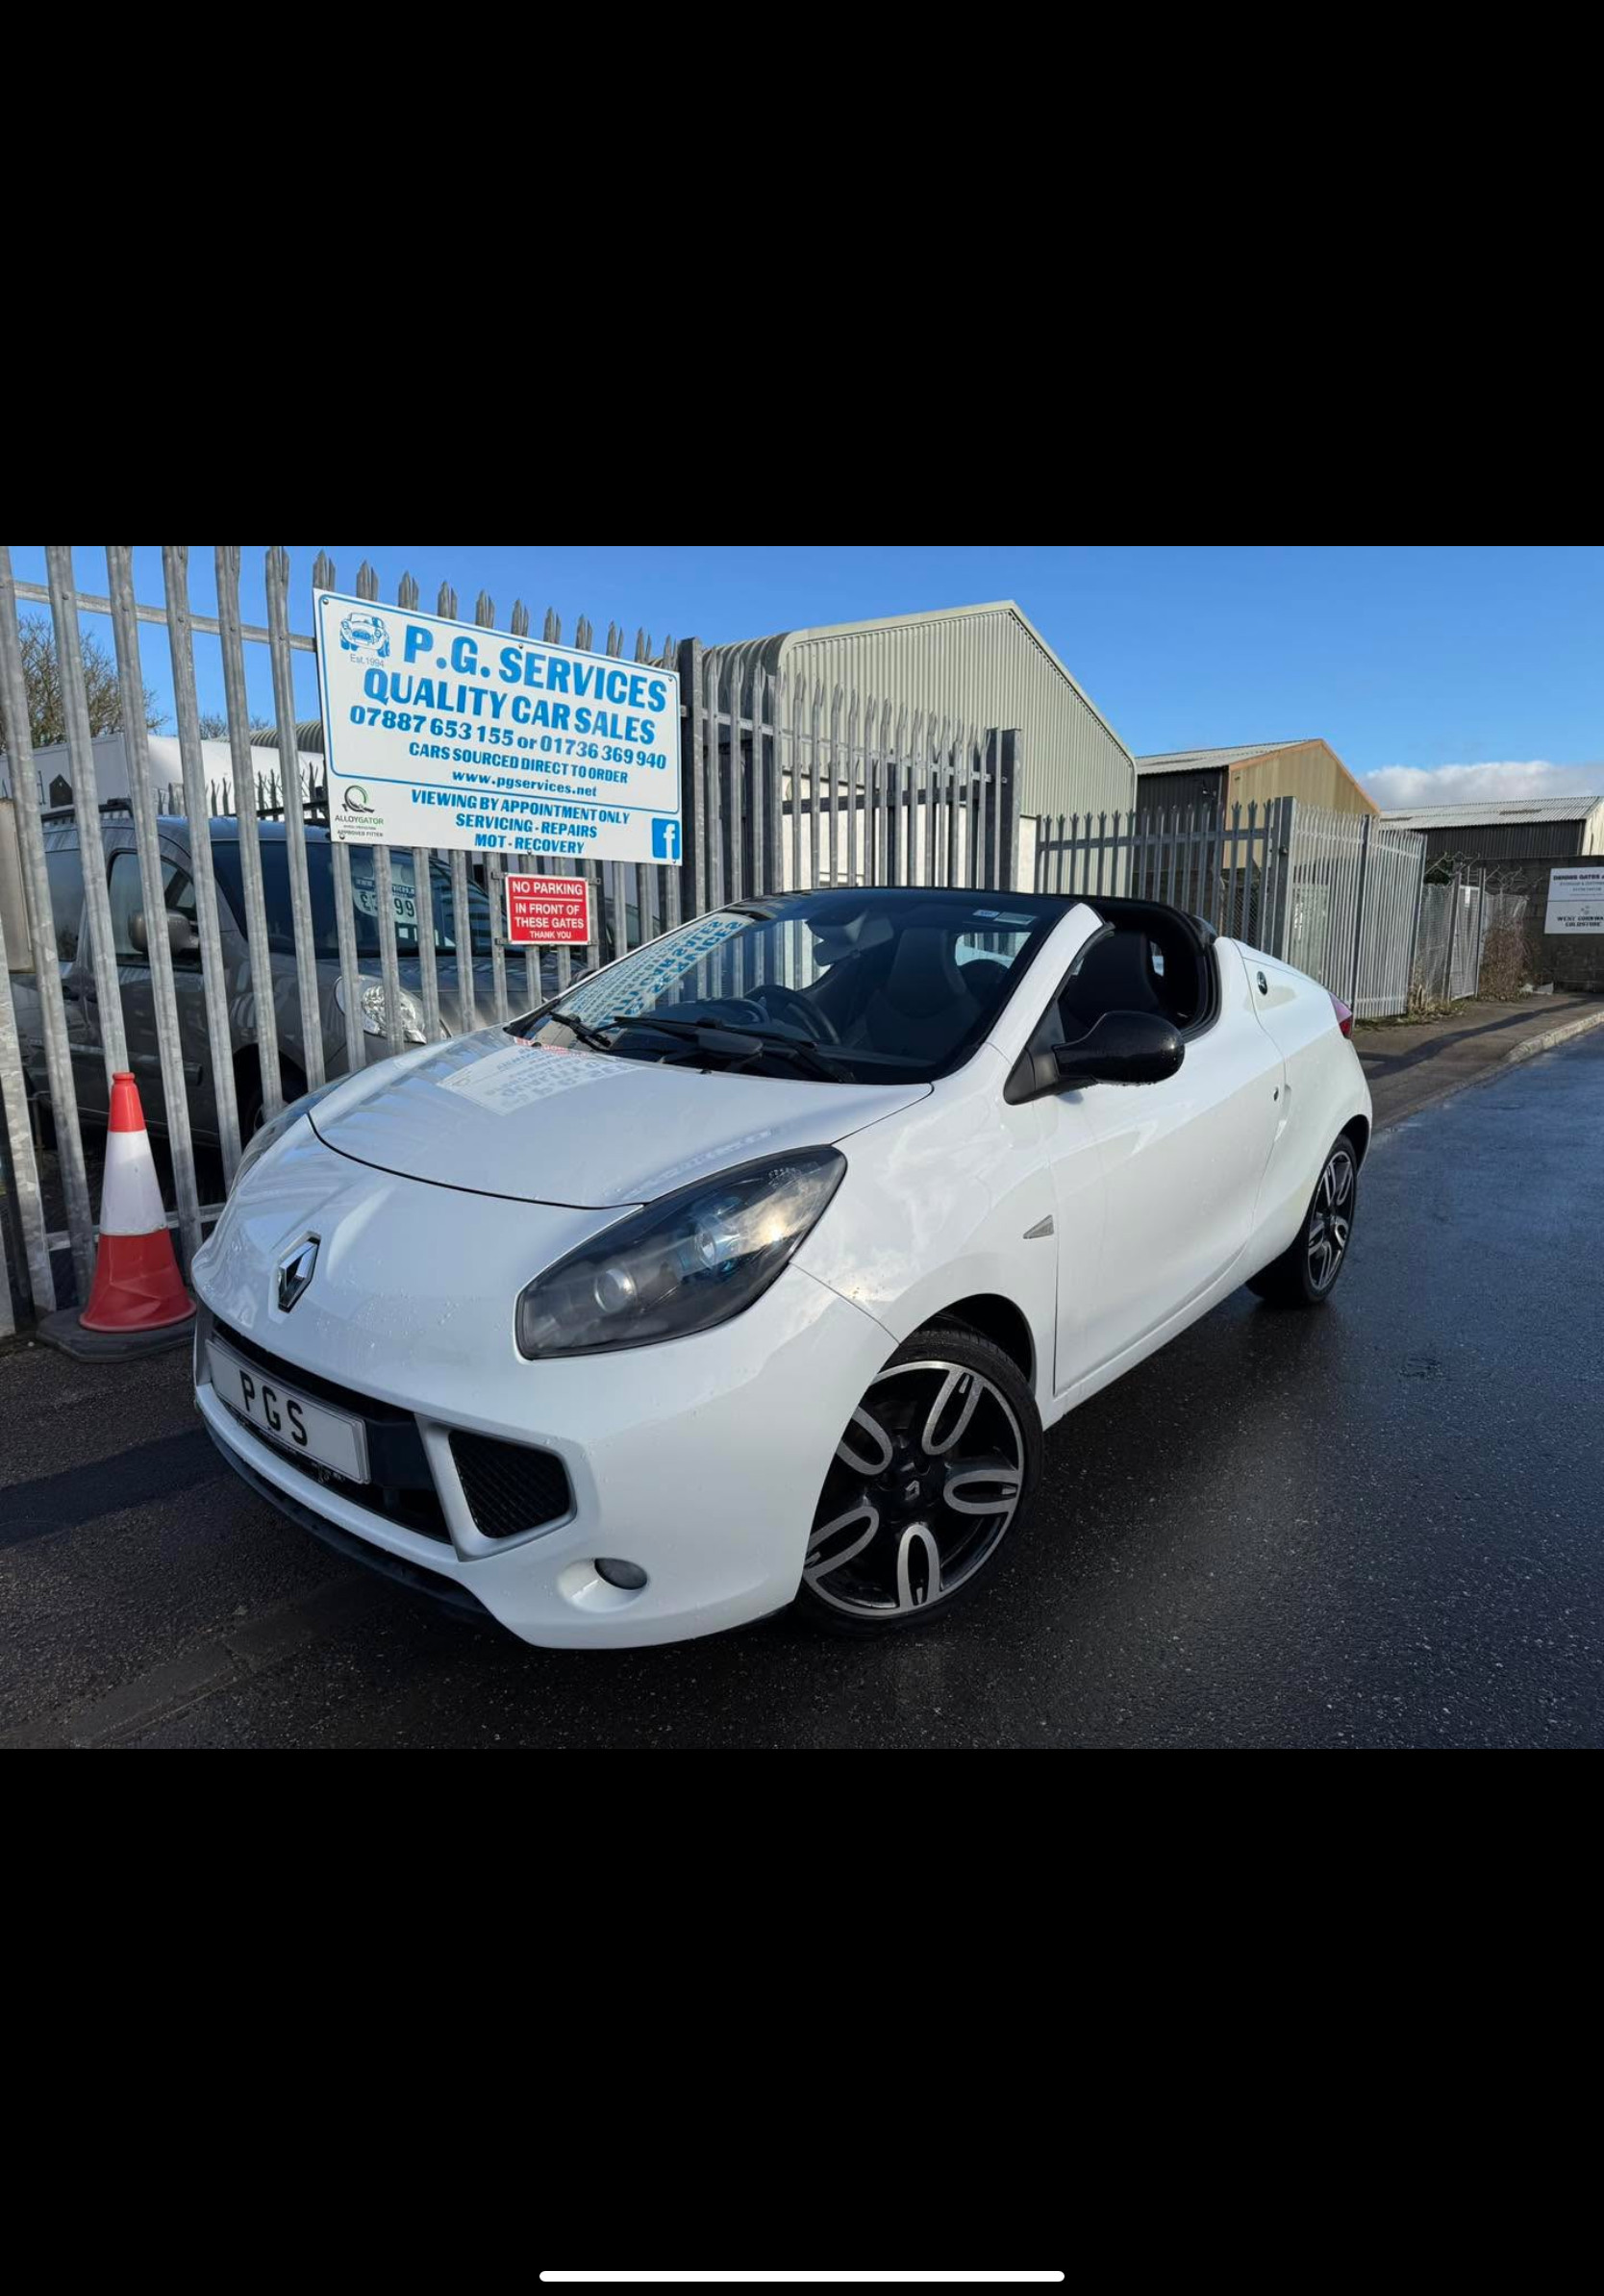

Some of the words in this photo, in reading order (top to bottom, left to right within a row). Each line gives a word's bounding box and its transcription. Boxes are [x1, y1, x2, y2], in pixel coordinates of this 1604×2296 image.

[404, 624, 490, 678] P.G.
[499, 647, 666, 712] SERVICES
[363, 667, 507, 719] QUALITY
[512, 695, 570, 731] CAR
[574, 707, 655, 744] SALES
[350, 705, 426, 733] 07887
[430, 718, 471, 740] 653
[477, 726, 514, 746] 155
[517, 736, 537, 749] or
[540, 736, 598, 759] 01736
[601, 745, 633, 764] 369
[637, 751, 666, 769] 940
[409, 742, 450, 760] CARS
[452, 748, 518, 769] SOURCED
[521, 758, 569, 776] DIRECT
[571, 764, 586, 778] TO
[589, 767, 628, 784] ORDER
[452, 771, 596, 797] www.pgservices.net
[412, 789, 477, 809] VIEWING
[480, 796, 499, 811] BY
[501, 799, 597, 820] APPOINTMENT
[599, 810, 630, 824] ONLY
[335, 815, 384, 825] ALLOYGATOR
[456, 813, 533, 833] SERVICING
[541, 821, 597, 838] REPAIRS
[475, 834, 507, 848] MOT
[514, 836, 584, 854] RECOVERY
[512, 881, 530, 893] NO
[534, 882, 583, 896] PARKING
[515, 903, 526, 914] IN
[529, 903, 564, 914] FRONT
[566, 905, 580, 915] OF
[514, 916, 549, 929] THESE
[552, 917, 584, 929] GATES
[530, 931, 555, 939] THANK
[557, 931, 571, 939] YOU
[239, 1368, 308, 1447] PGS
